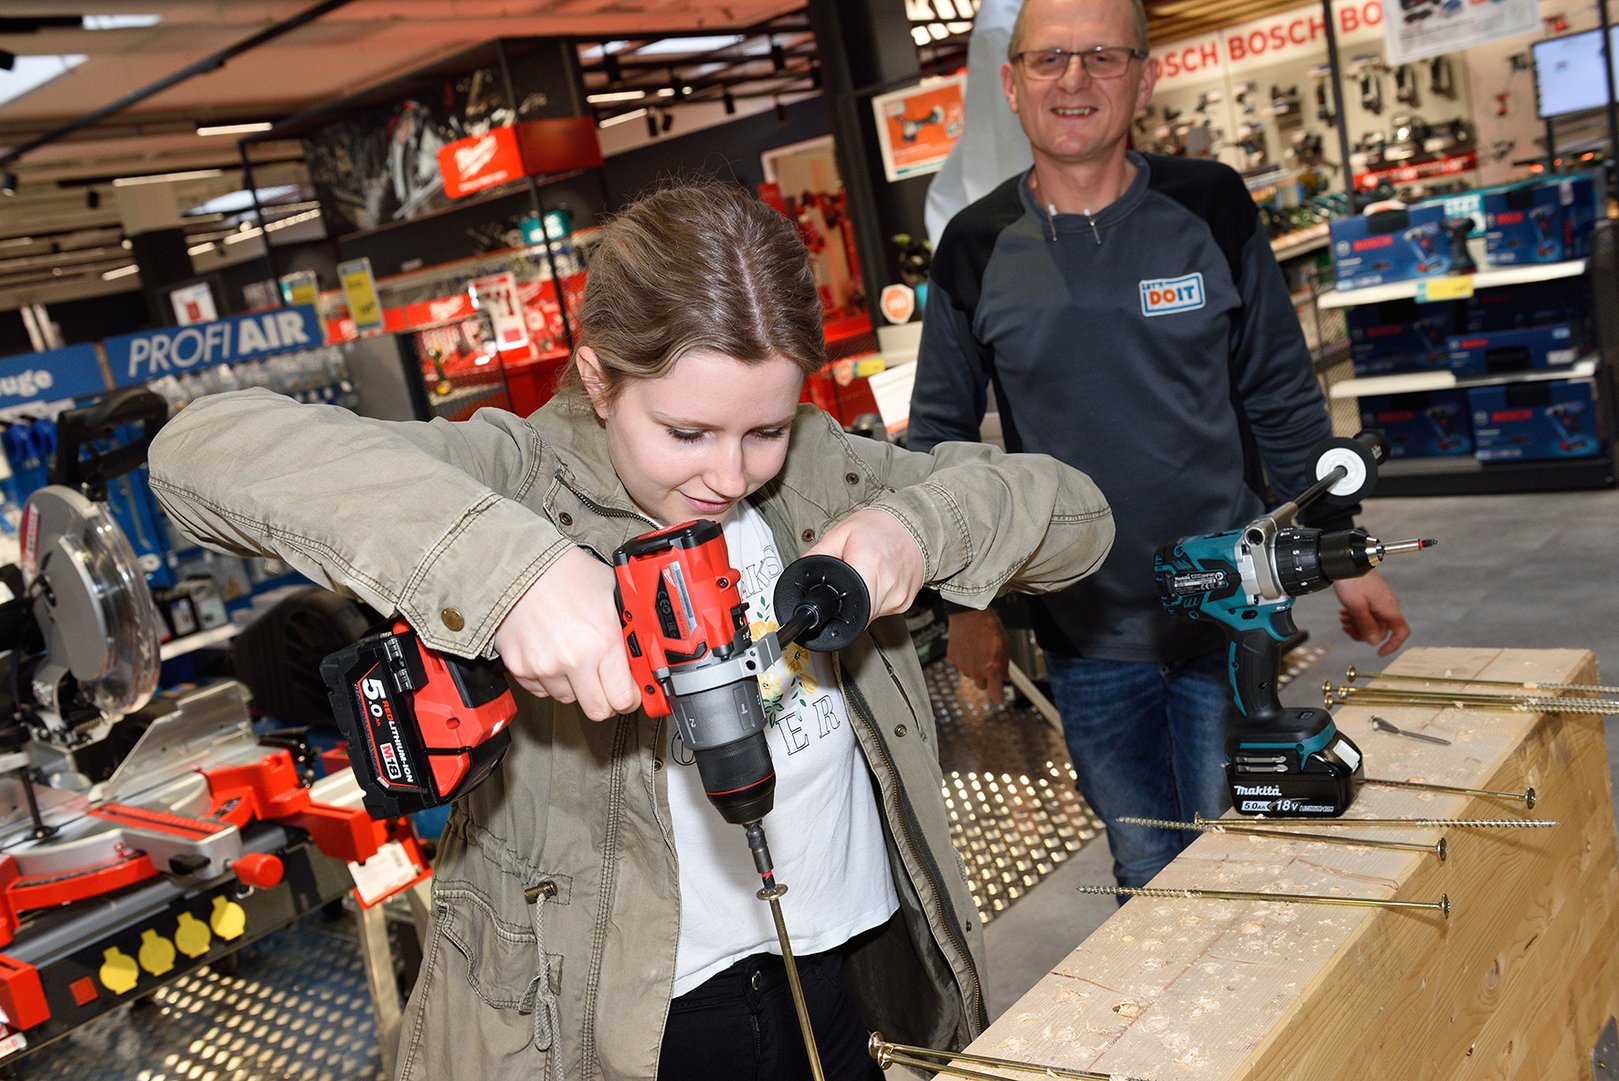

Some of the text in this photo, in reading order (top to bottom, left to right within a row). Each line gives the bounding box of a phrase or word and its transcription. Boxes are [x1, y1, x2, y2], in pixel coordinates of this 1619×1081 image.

[1228, 16, 1326, 61] BOSCH
[128, 310, 311, 377] PROFI AIR
[361, 678, 387, 718] 5.0
[382, 744, 400, 778] M18
